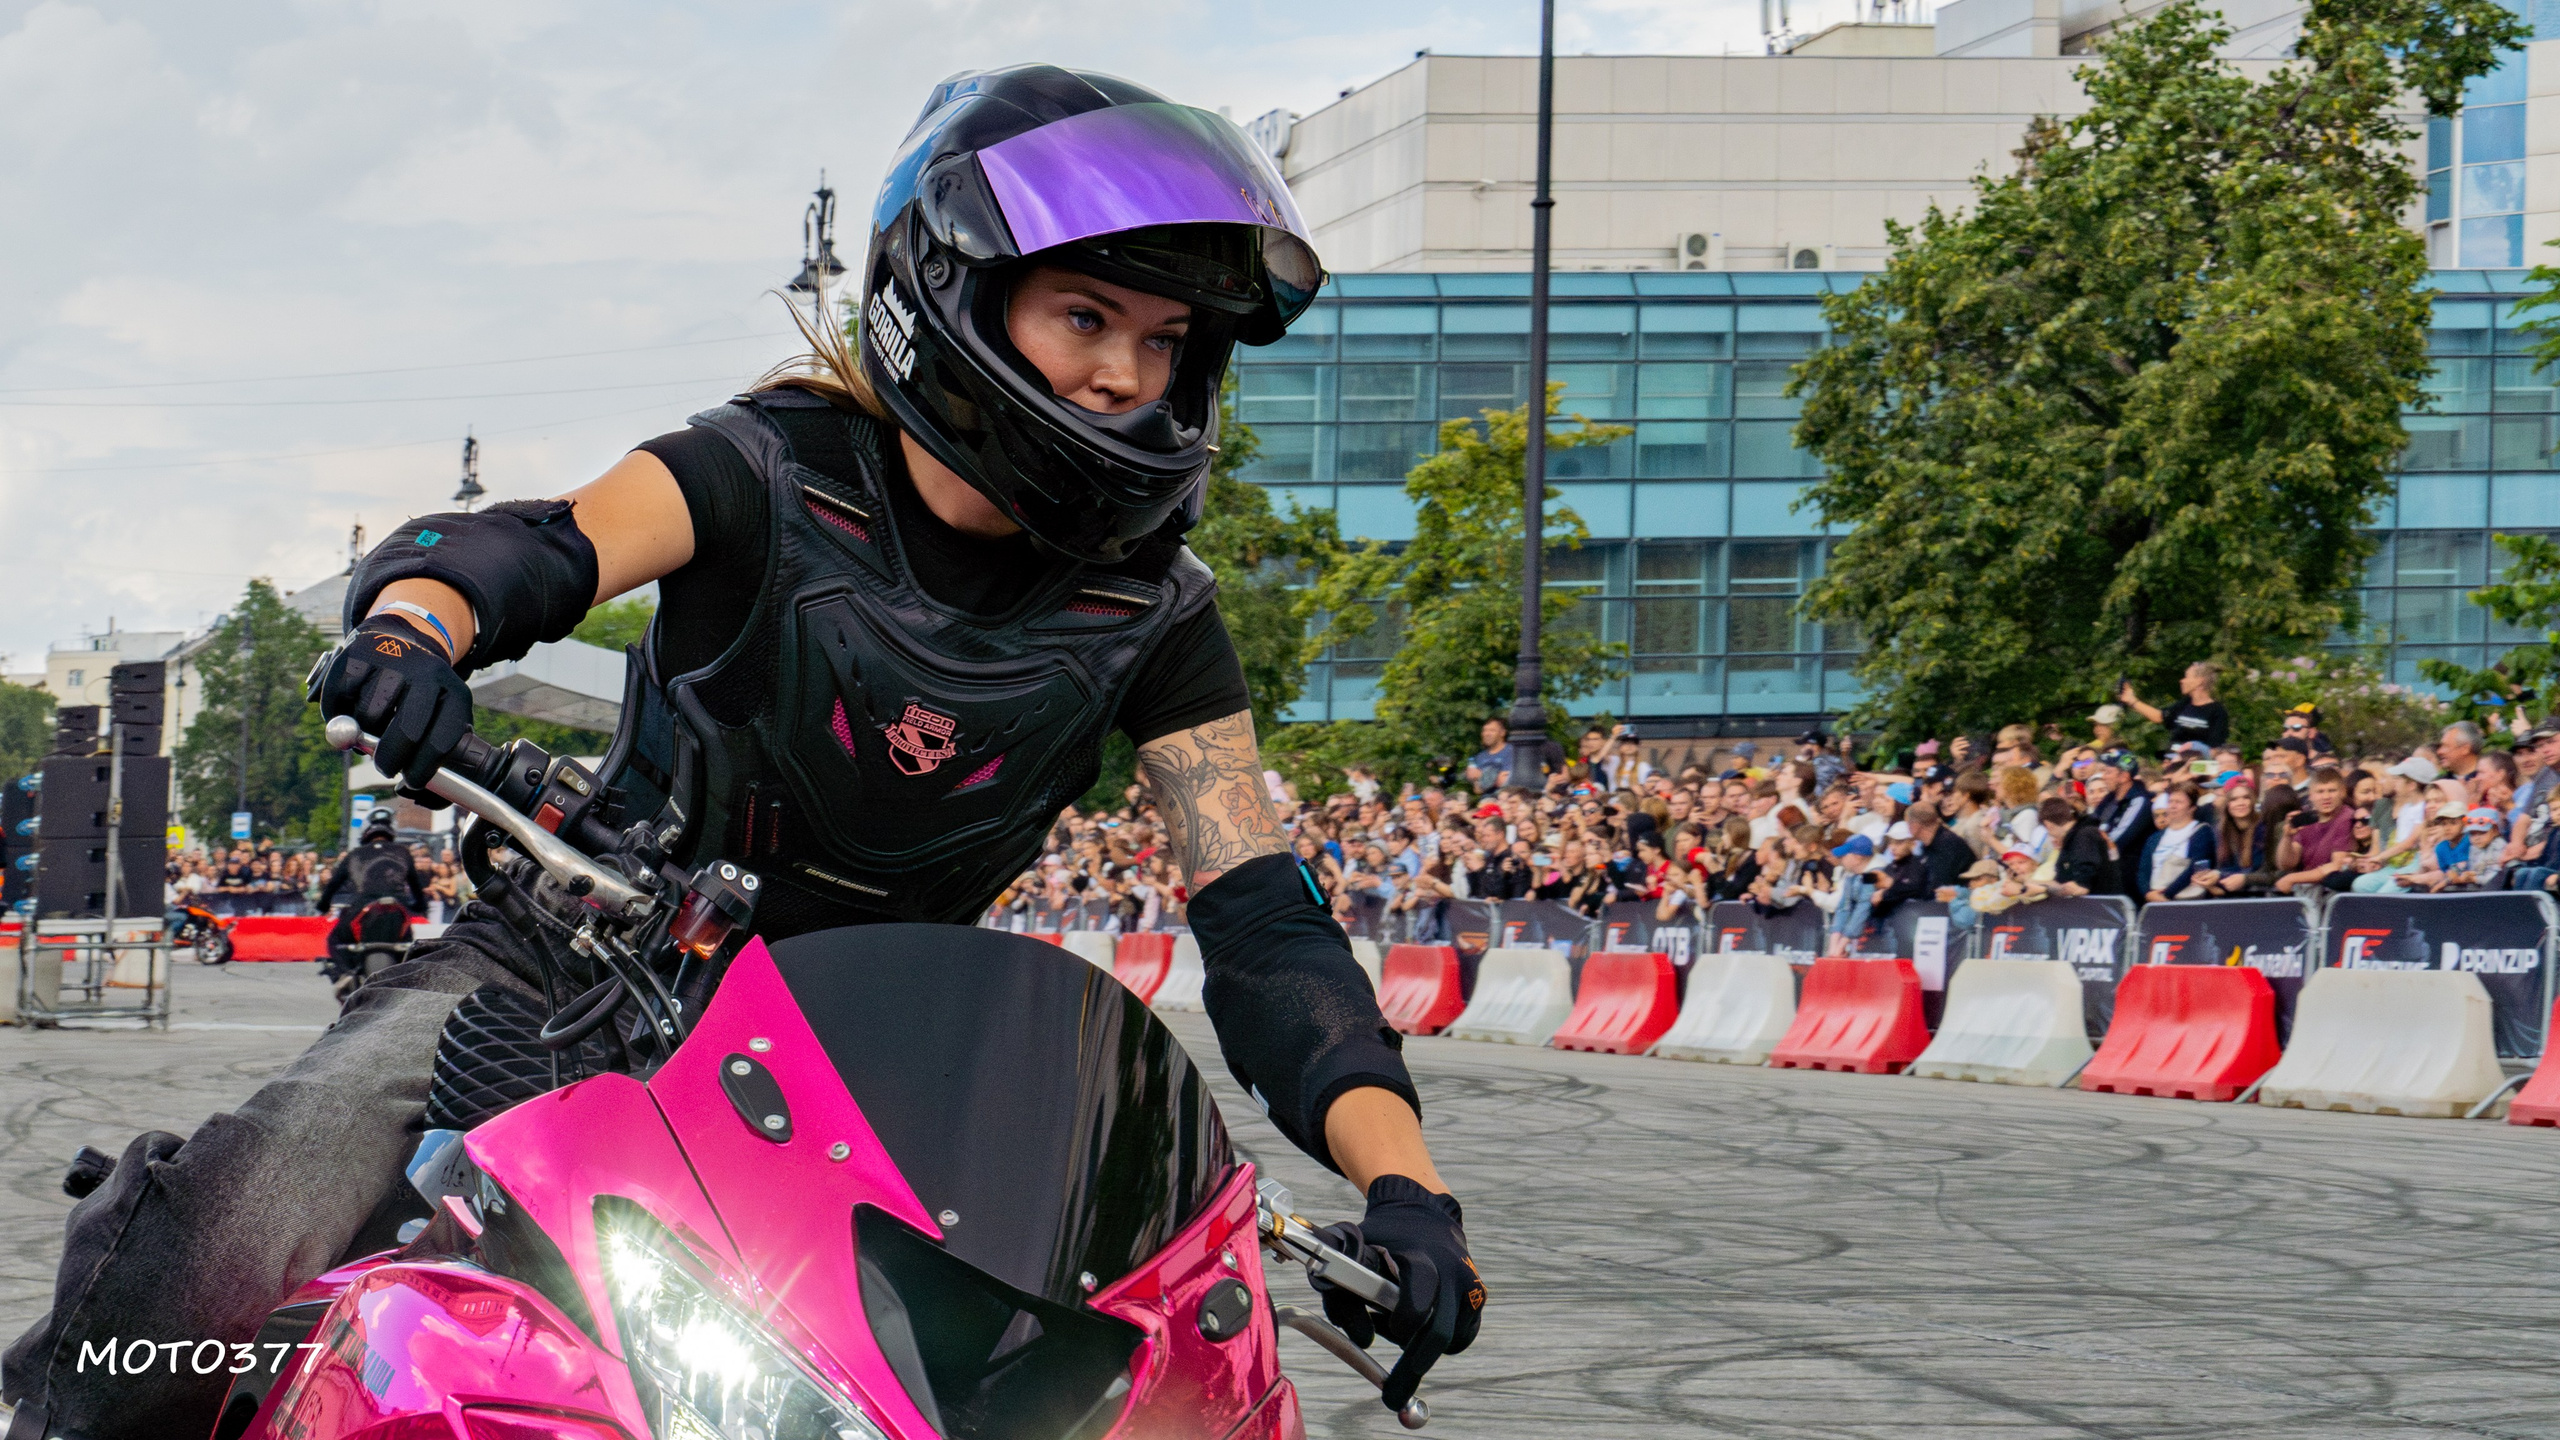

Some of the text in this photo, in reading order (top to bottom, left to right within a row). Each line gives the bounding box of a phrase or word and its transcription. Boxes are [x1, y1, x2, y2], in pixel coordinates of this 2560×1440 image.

[868, 292, 916, 381] GORILLA
[868, 329, 901, 385] ENERGY DRINK
[902, 716, 952, 737] FIELD ARMOR
[890, 733, 931, 758] PROTECT
[2056, 927, 2120, 964] VIRAX
[2460, 948, 2540, 974] PRINZIP
